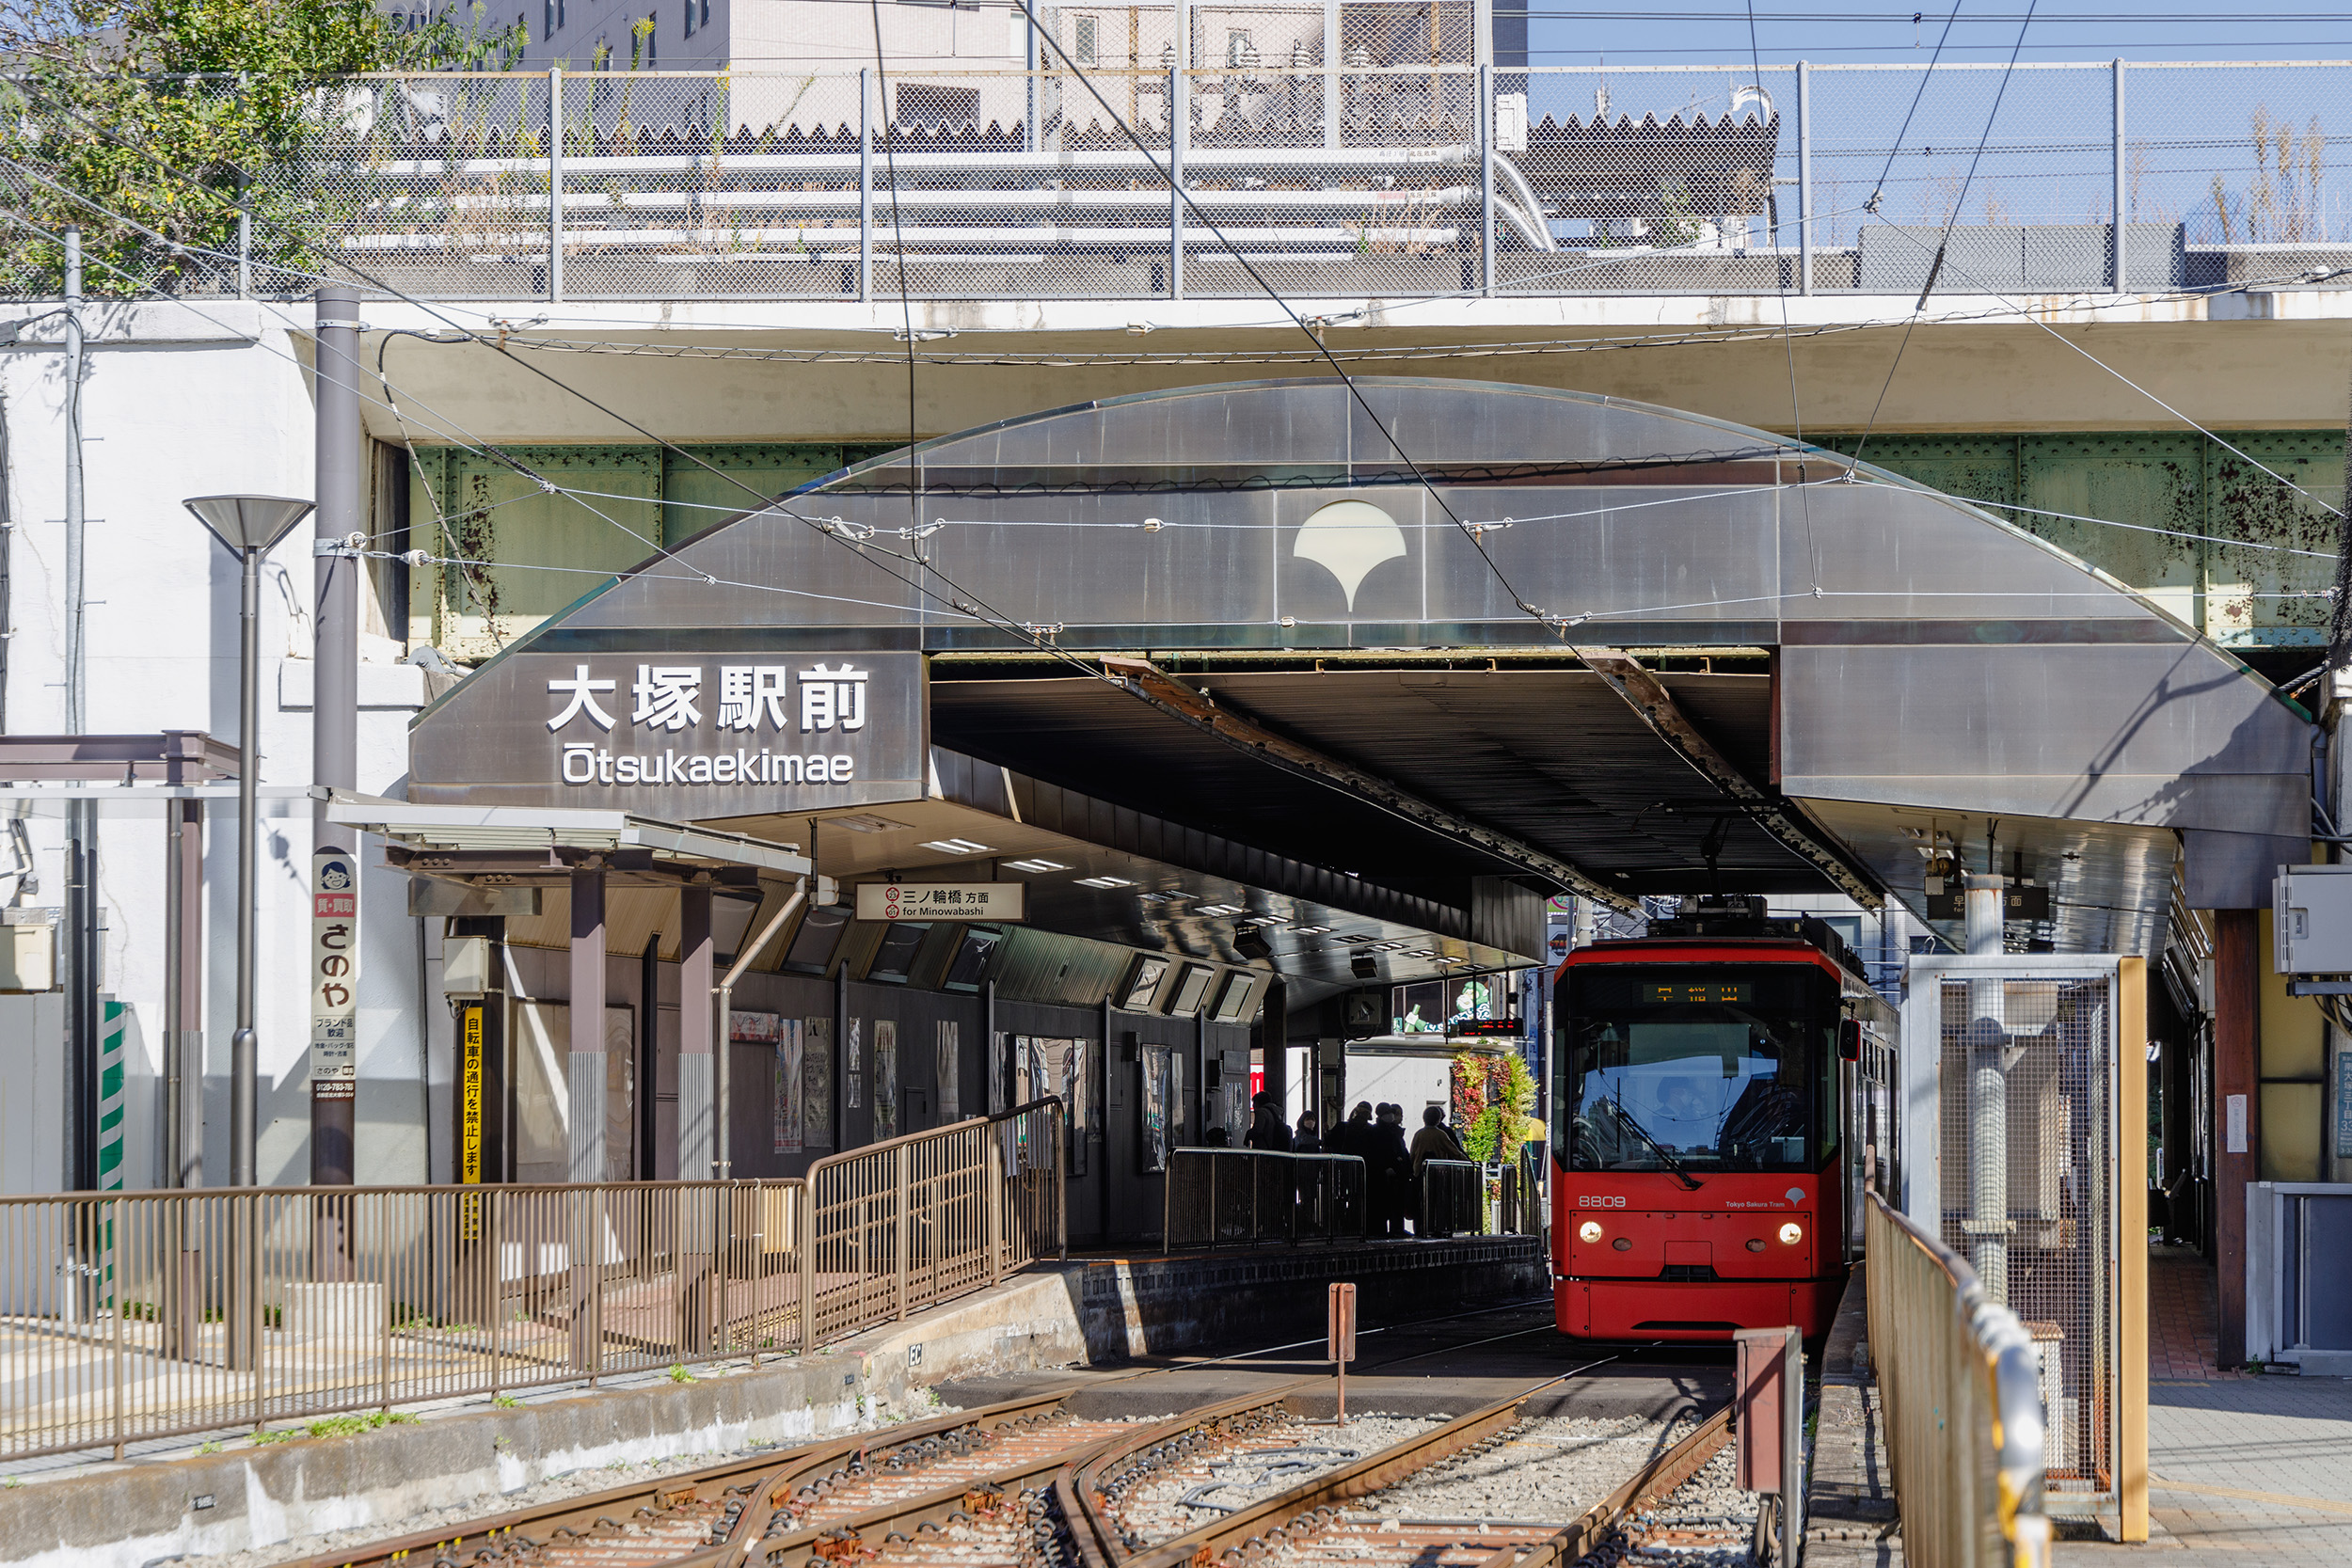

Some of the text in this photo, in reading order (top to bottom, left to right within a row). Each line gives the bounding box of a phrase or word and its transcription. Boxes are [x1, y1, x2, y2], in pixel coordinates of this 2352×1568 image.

[547, 662, 868, 732] 大塚駅前
[563, 743, 854, 784] Ōtsukaekimae
[903, 890, 989, 904] 三ノ輪橋 方面
[317, 898, 354, 913] 質・買取
[903, 907, 984, 915] for Minowabashi
[321, 924, 349, 1007] さのや
[316, 1019, 353, 1027] ブランド品
[327, 1028, 344, 1037] 歓迎
[466, 1018, 479, 1176] 自転車の通行を禁止します
[1579, 1196, 1626, 1208] 8809
[910, 1344, 921, 1366] EC
